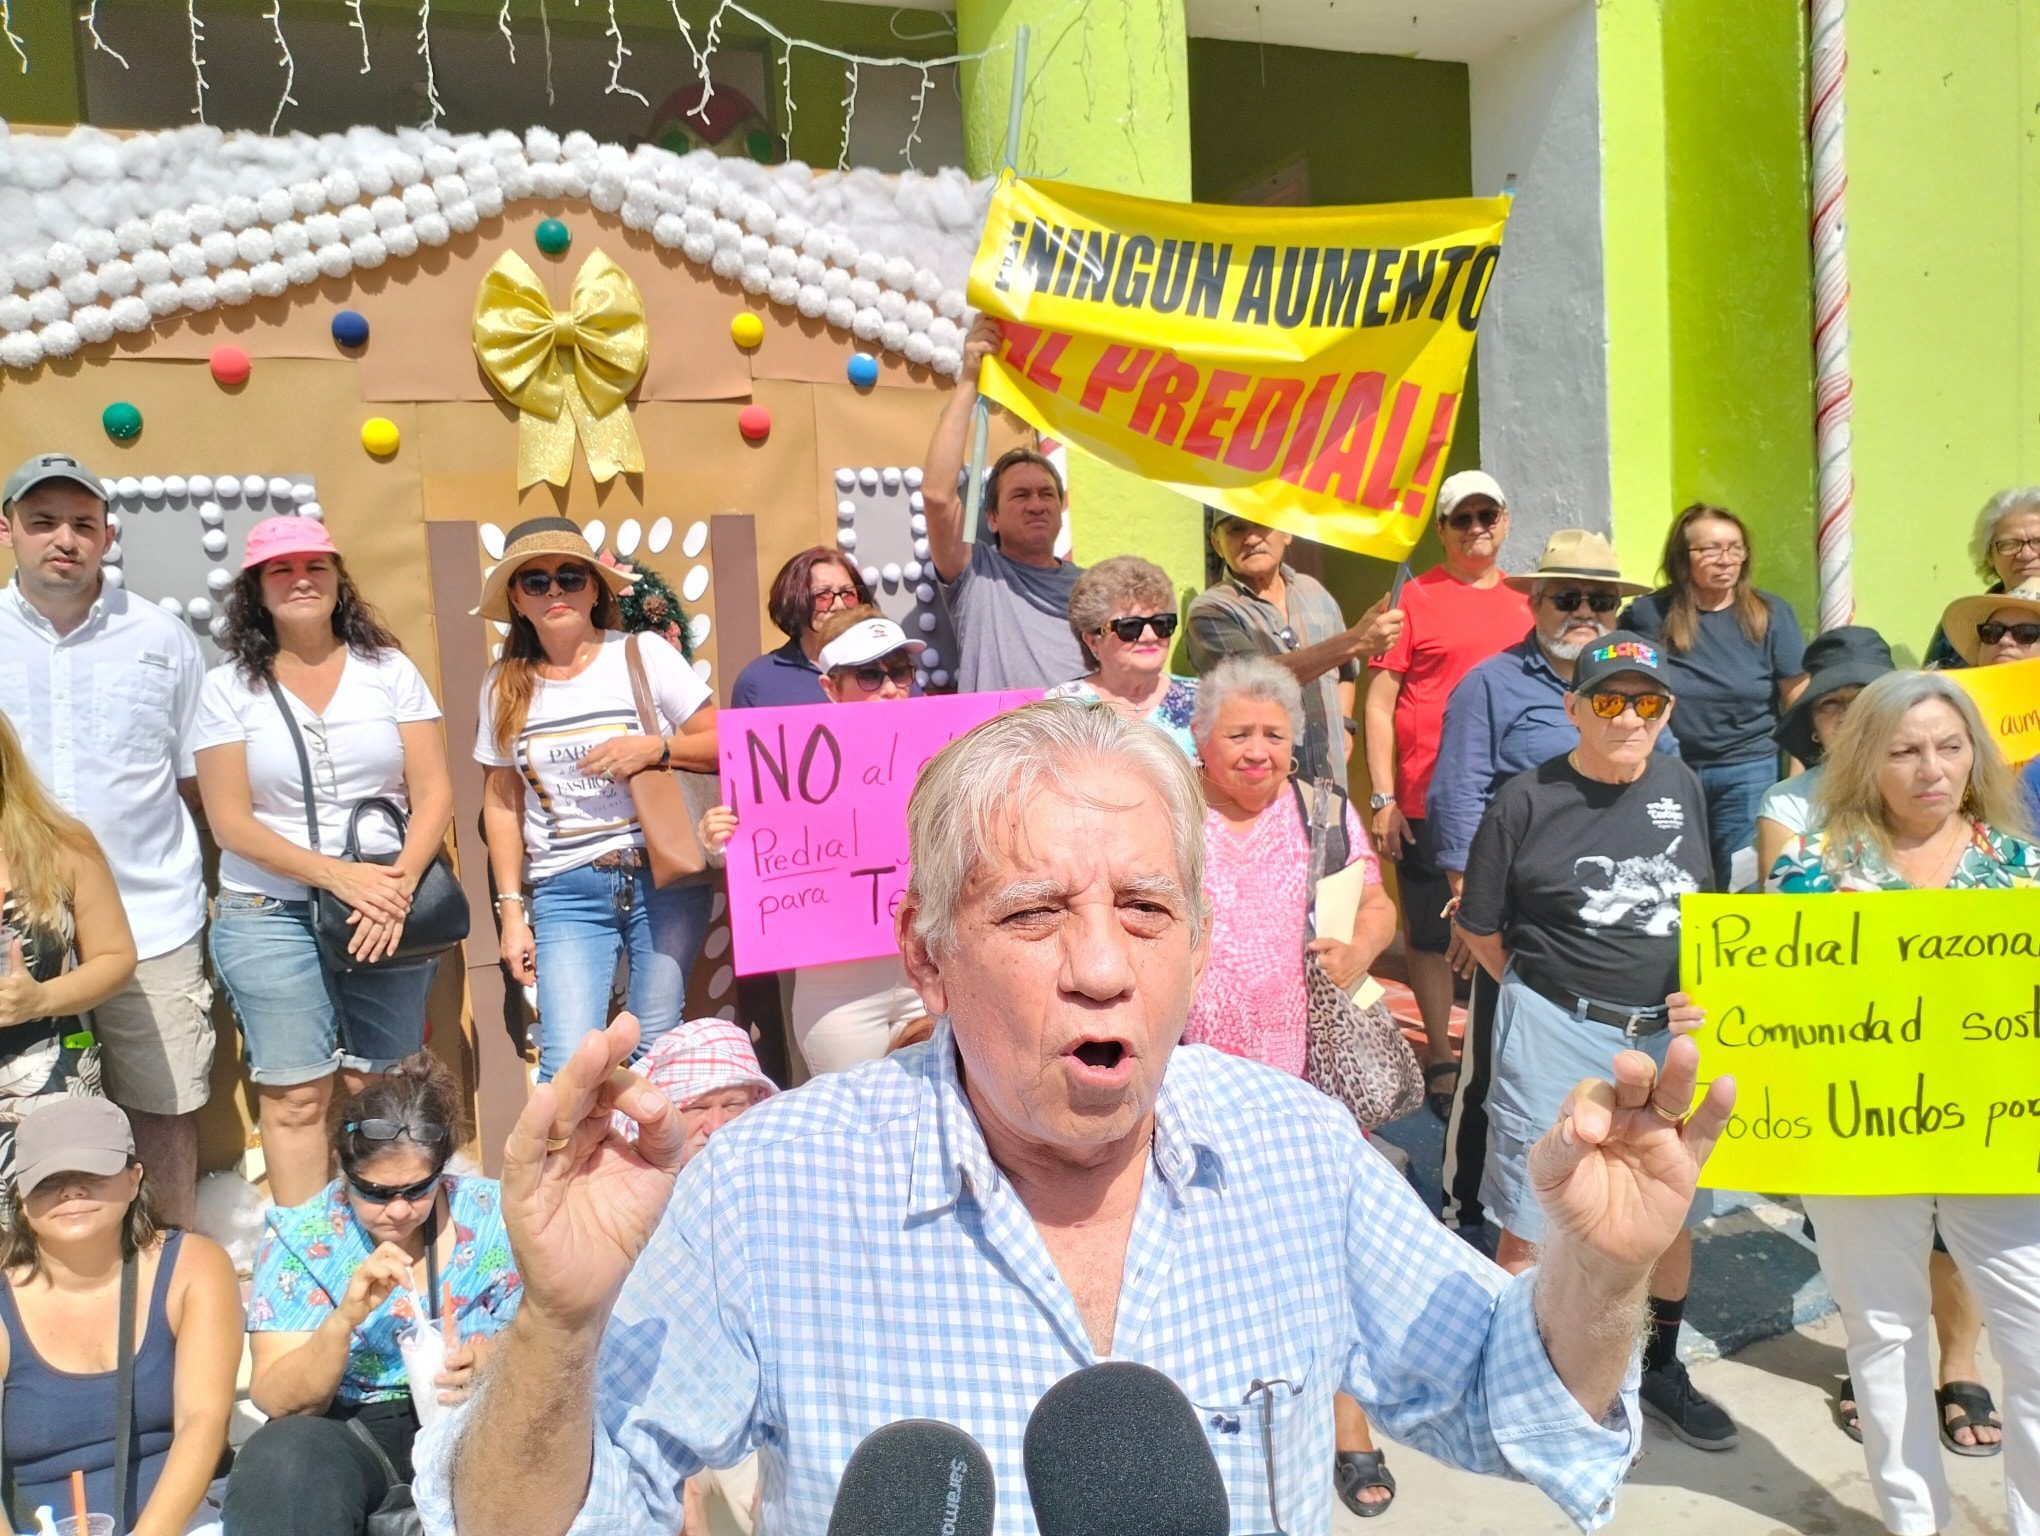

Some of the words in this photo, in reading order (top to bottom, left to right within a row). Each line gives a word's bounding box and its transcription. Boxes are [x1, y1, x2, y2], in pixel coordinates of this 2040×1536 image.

[1234, 244, 1502, 331] AUMENTO
[994, 318, 1073, 394] AL
[1080, 346, 1459, 519] PREDIAL!
[549, 744, 592, 763] PAR
[863, 732, 898, 785] al
[556, 776, 615, 795] FASHIO
[752, 808, 858, 876] Predial
[759, 888, 830, 935] para
[1695, 911, 1860, 985] ¡Predial
[1897, 932, 2040, 961] razona
[1716, 996, 1922, 1049] Comunidad
[1828, 1073, 1965, 1138] Unidos
